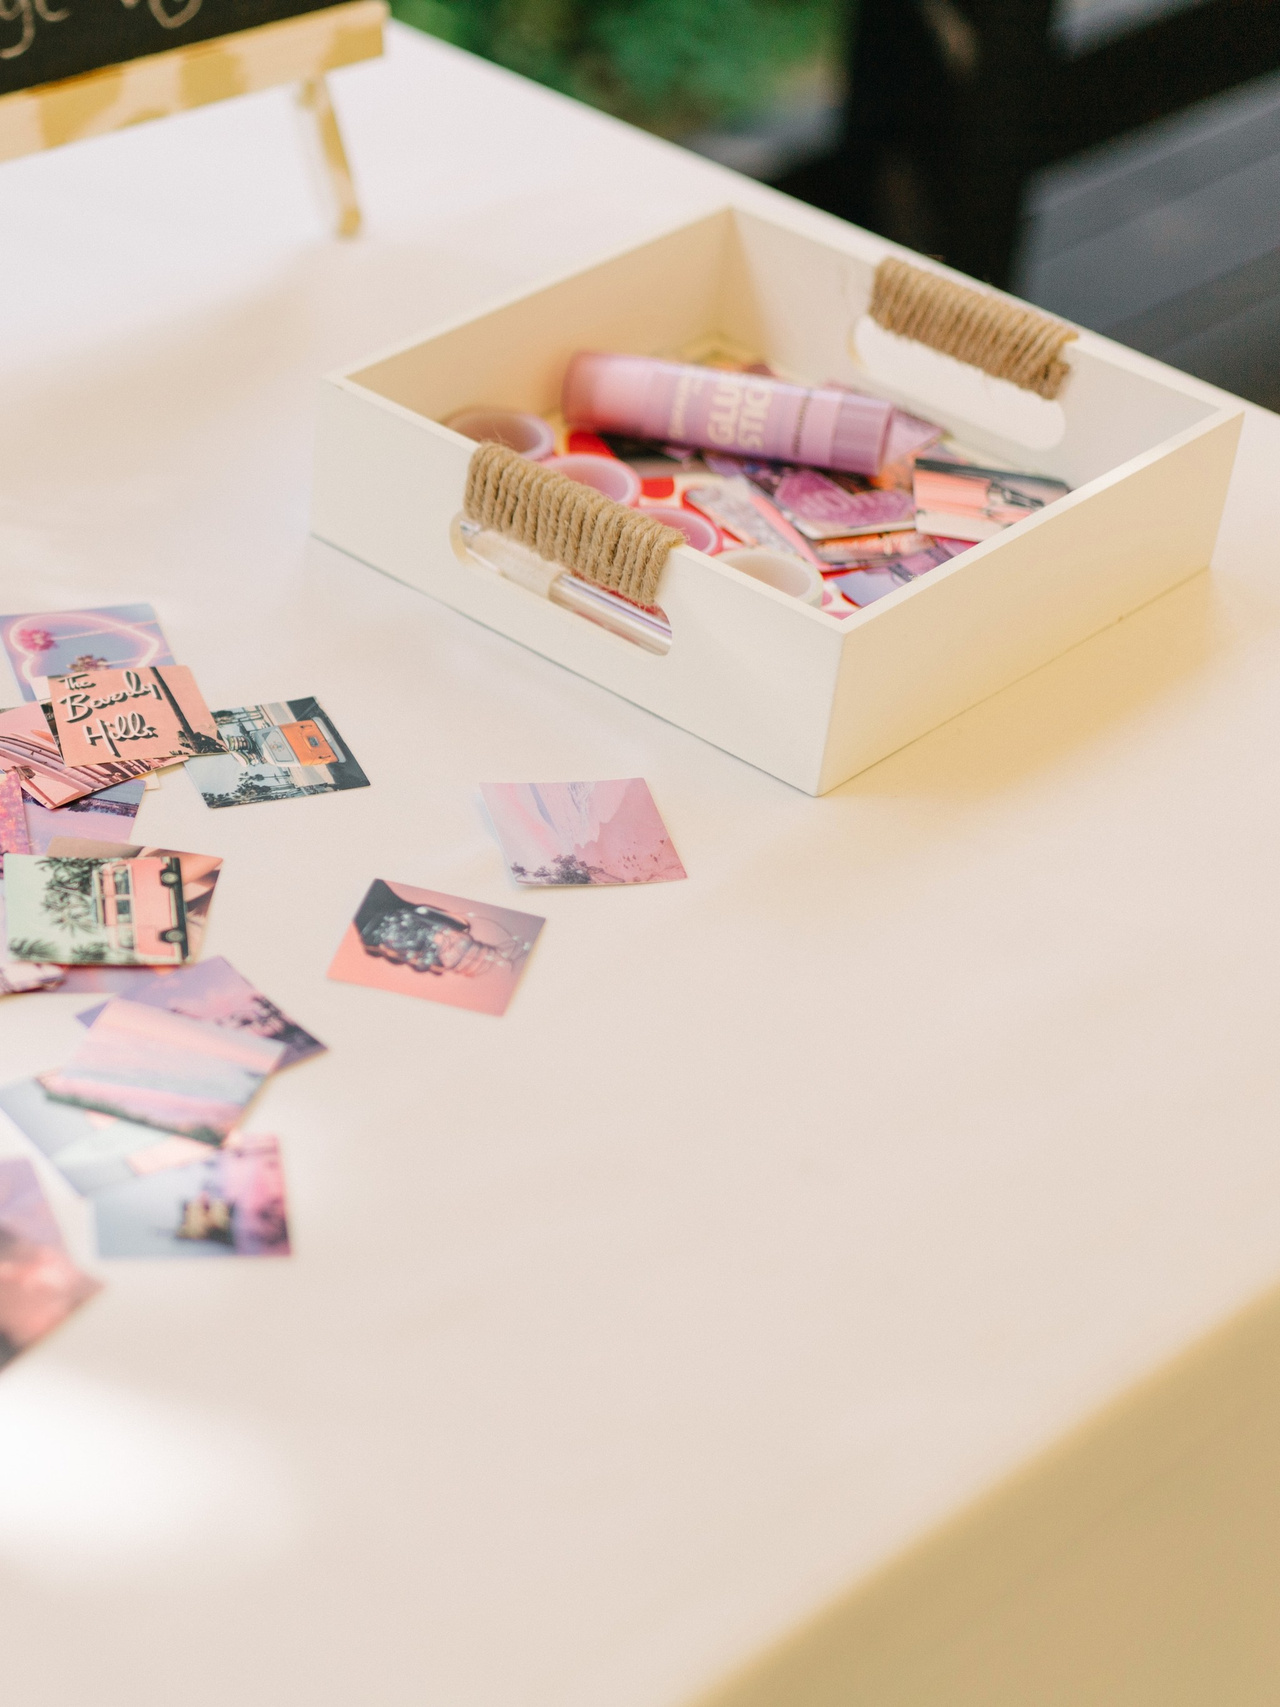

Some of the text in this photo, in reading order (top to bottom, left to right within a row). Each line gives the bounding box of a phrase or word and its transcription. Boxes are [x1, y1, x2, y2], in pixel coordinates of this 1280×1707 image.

[707, 373, 744, 446] GLU
[737, 377, 774, 450] STIC
[58, 673, 96, 690] The
[58, 670, 162, 723] Beverly
[82, 711, 158, 757] Hills
